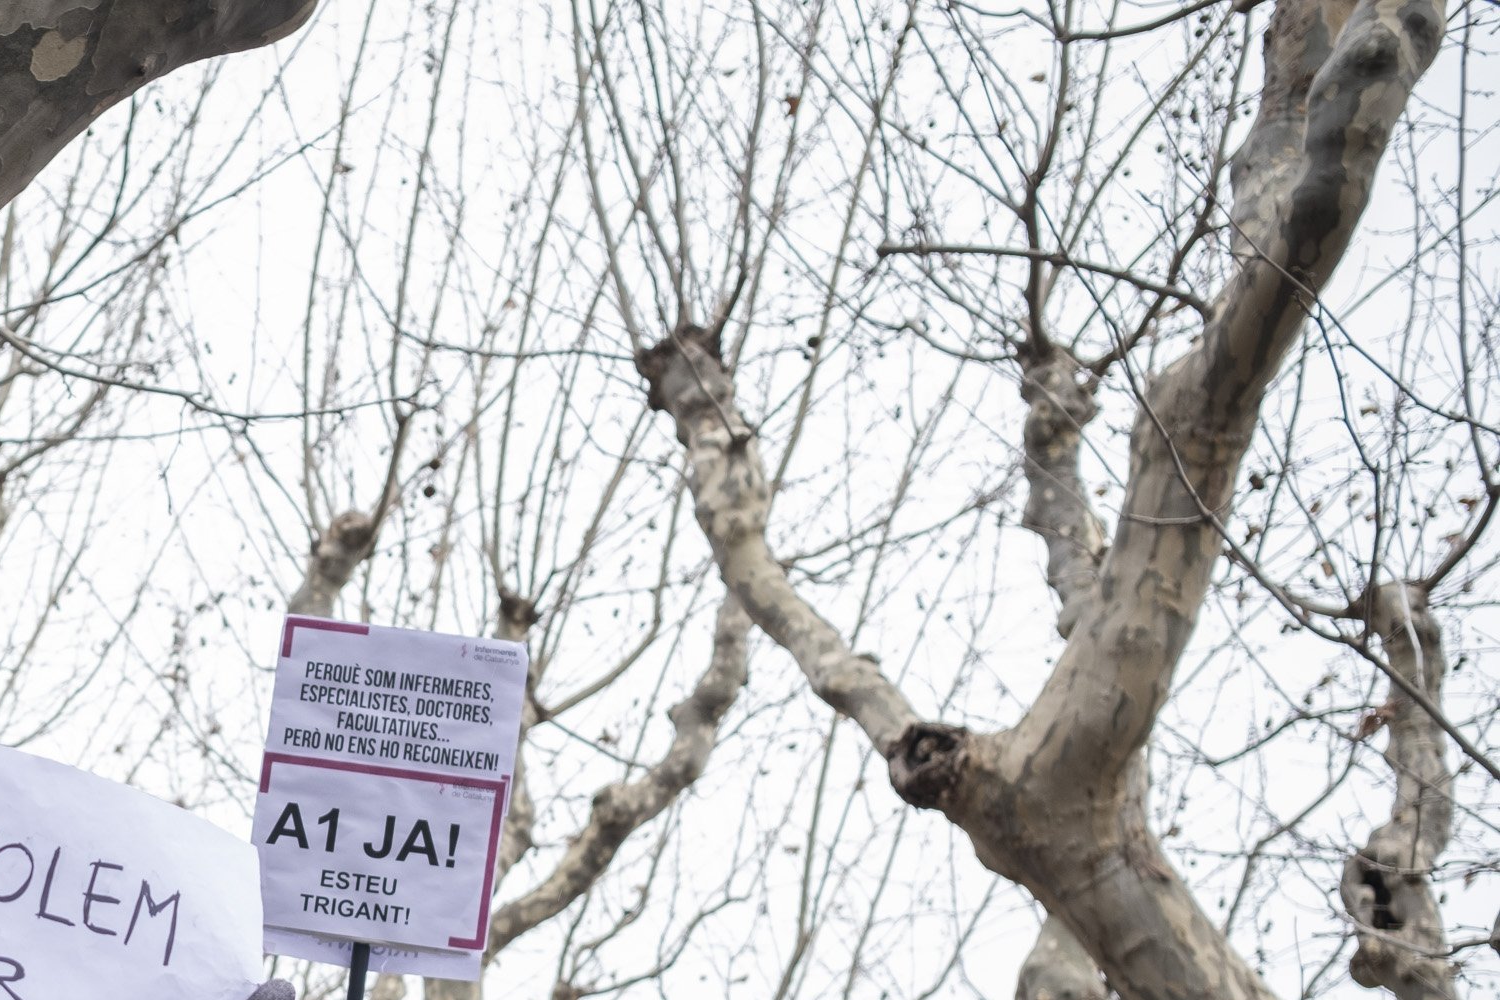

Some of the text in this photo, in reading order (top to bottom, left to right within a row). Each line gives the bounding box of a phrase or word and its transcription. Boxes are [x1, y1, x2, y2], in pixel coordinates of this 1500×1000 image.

[305, 661, 494, 703] PERQUÈ SOM INFERMERES,
[300, 683, 493, 726] ESPECIALISTES, DOCTORES,
[337, 711, 450, 742] FACULTATIVES...
[283, 727, 499, 771] PERÒ NO ENS HO RECONEIXEN!
[265, 802, 461, 869] A1 JA!
[319, 869, 398, 896] ESTEU
[300, 893, 411, 925] TRIGANT!
